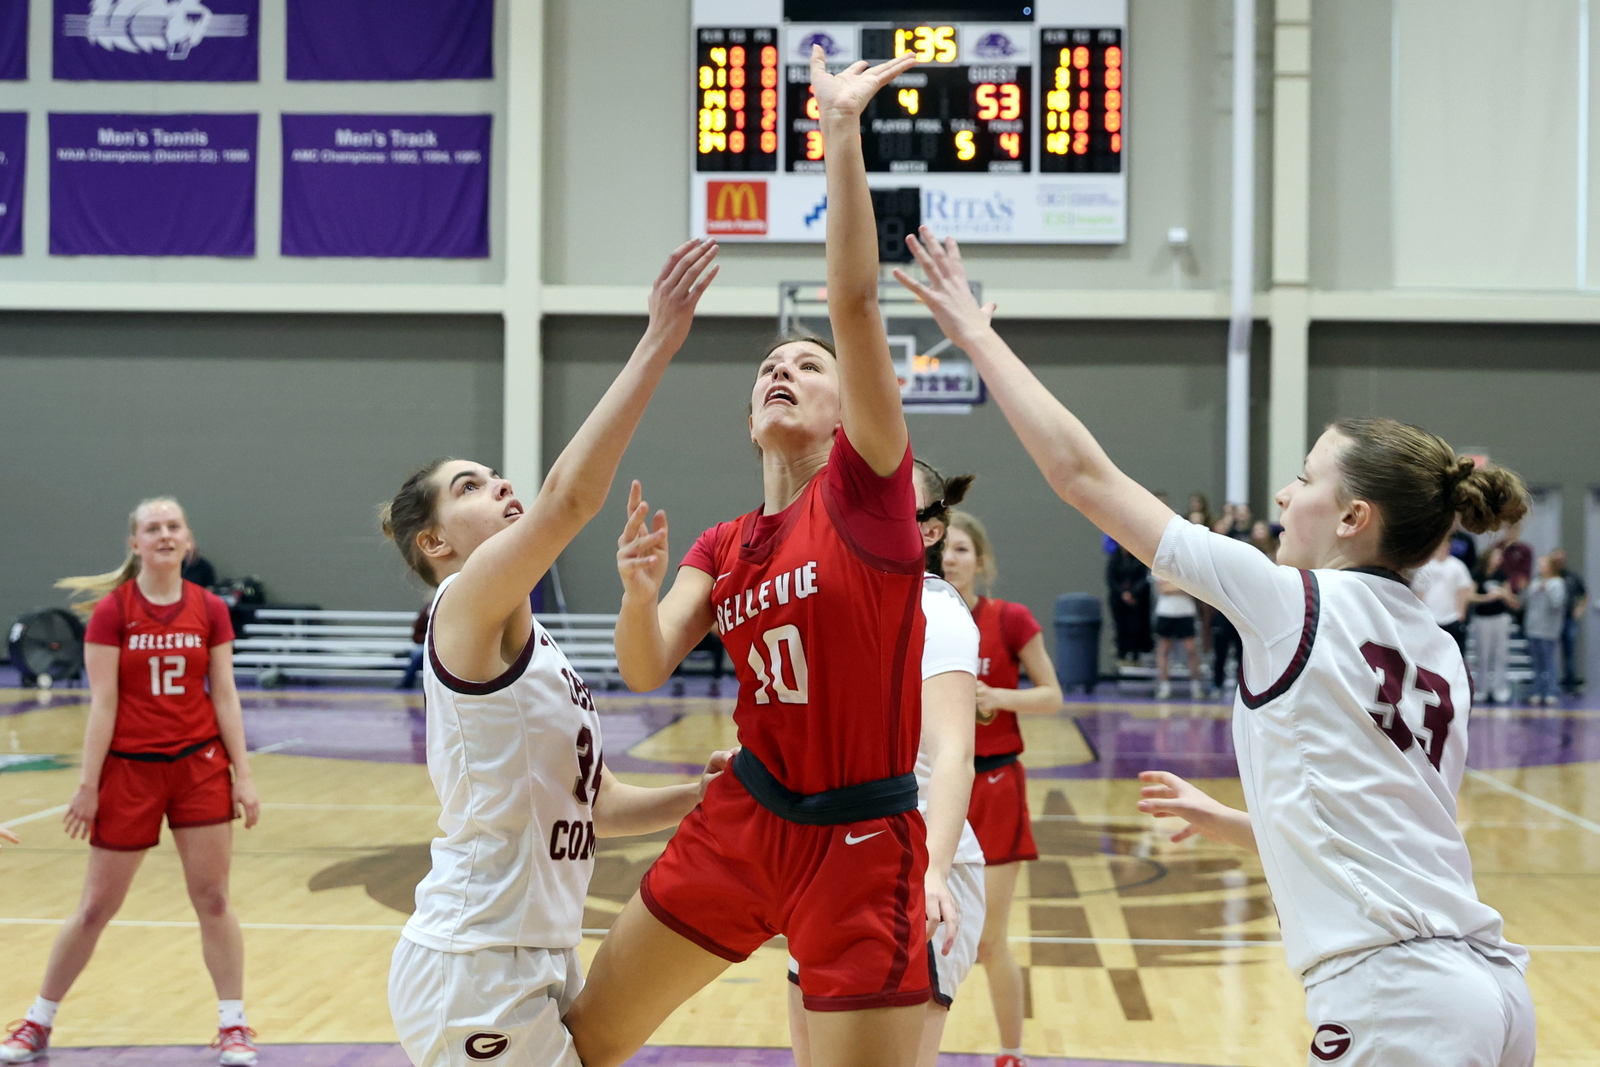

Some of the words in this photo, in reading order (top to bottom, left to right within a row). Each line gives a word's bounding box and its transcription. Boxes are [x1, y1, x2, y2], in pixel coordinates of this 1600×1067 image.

[895, 26, 957, 63] 1:35
[710, 47, 727, 67] 4
[1060, 48, 1070, 67] 1
[699, 66, 727, 89] 31
[968, 67, 1017, 83] GUEST
[1079, 68, 1089, 88] 1
[898, 88, 919, 114] 4
[975, 83, 1020, 120] 53
[1079, 90, 1089, 110] 1
[699, 108, 726, 131] 33
[735, 110, 745, 130] 1
[872, 120, 912, 132] PLAYER
[915, 120, 942, 132] FOUL
[988, 120, 1022, 133] FOULS
[1047, 110, 1070, 131] 11
[98, 128, 148, 147] Men's
[151, 128, 208, 146] Tennis
[335, 129, 387, 147] Men's
[389, 129, 438, 147] Track
[699, 130, 726, 153] 34
[806, 130, 824, 160] 3
[955, 130, 975, 160] 5
[1000, 132, 1020, 158] 4
[1047, 131, 1070, 154] 12
[1111, 133, 1121, 153] 1
[58, 149, 85, 161] NAIA
[87, 149, 151, 164] Champions
[292, 149, 319, 162] AMC
[890, 160, 927, 172] MATCH
[989, 160, 1023, 172] SCORE
[717, 561, 818, 636] BELLEVUE
[128, 633, 202, 650] BELLEVUE
[148, 655, 186, 696] 12
[747, 624, 808, 704] 10
[1358, 639, 1454, 773] 33
[464, 1031, 510, 1061] G
[1311, 1021, 1353, 1063] G
